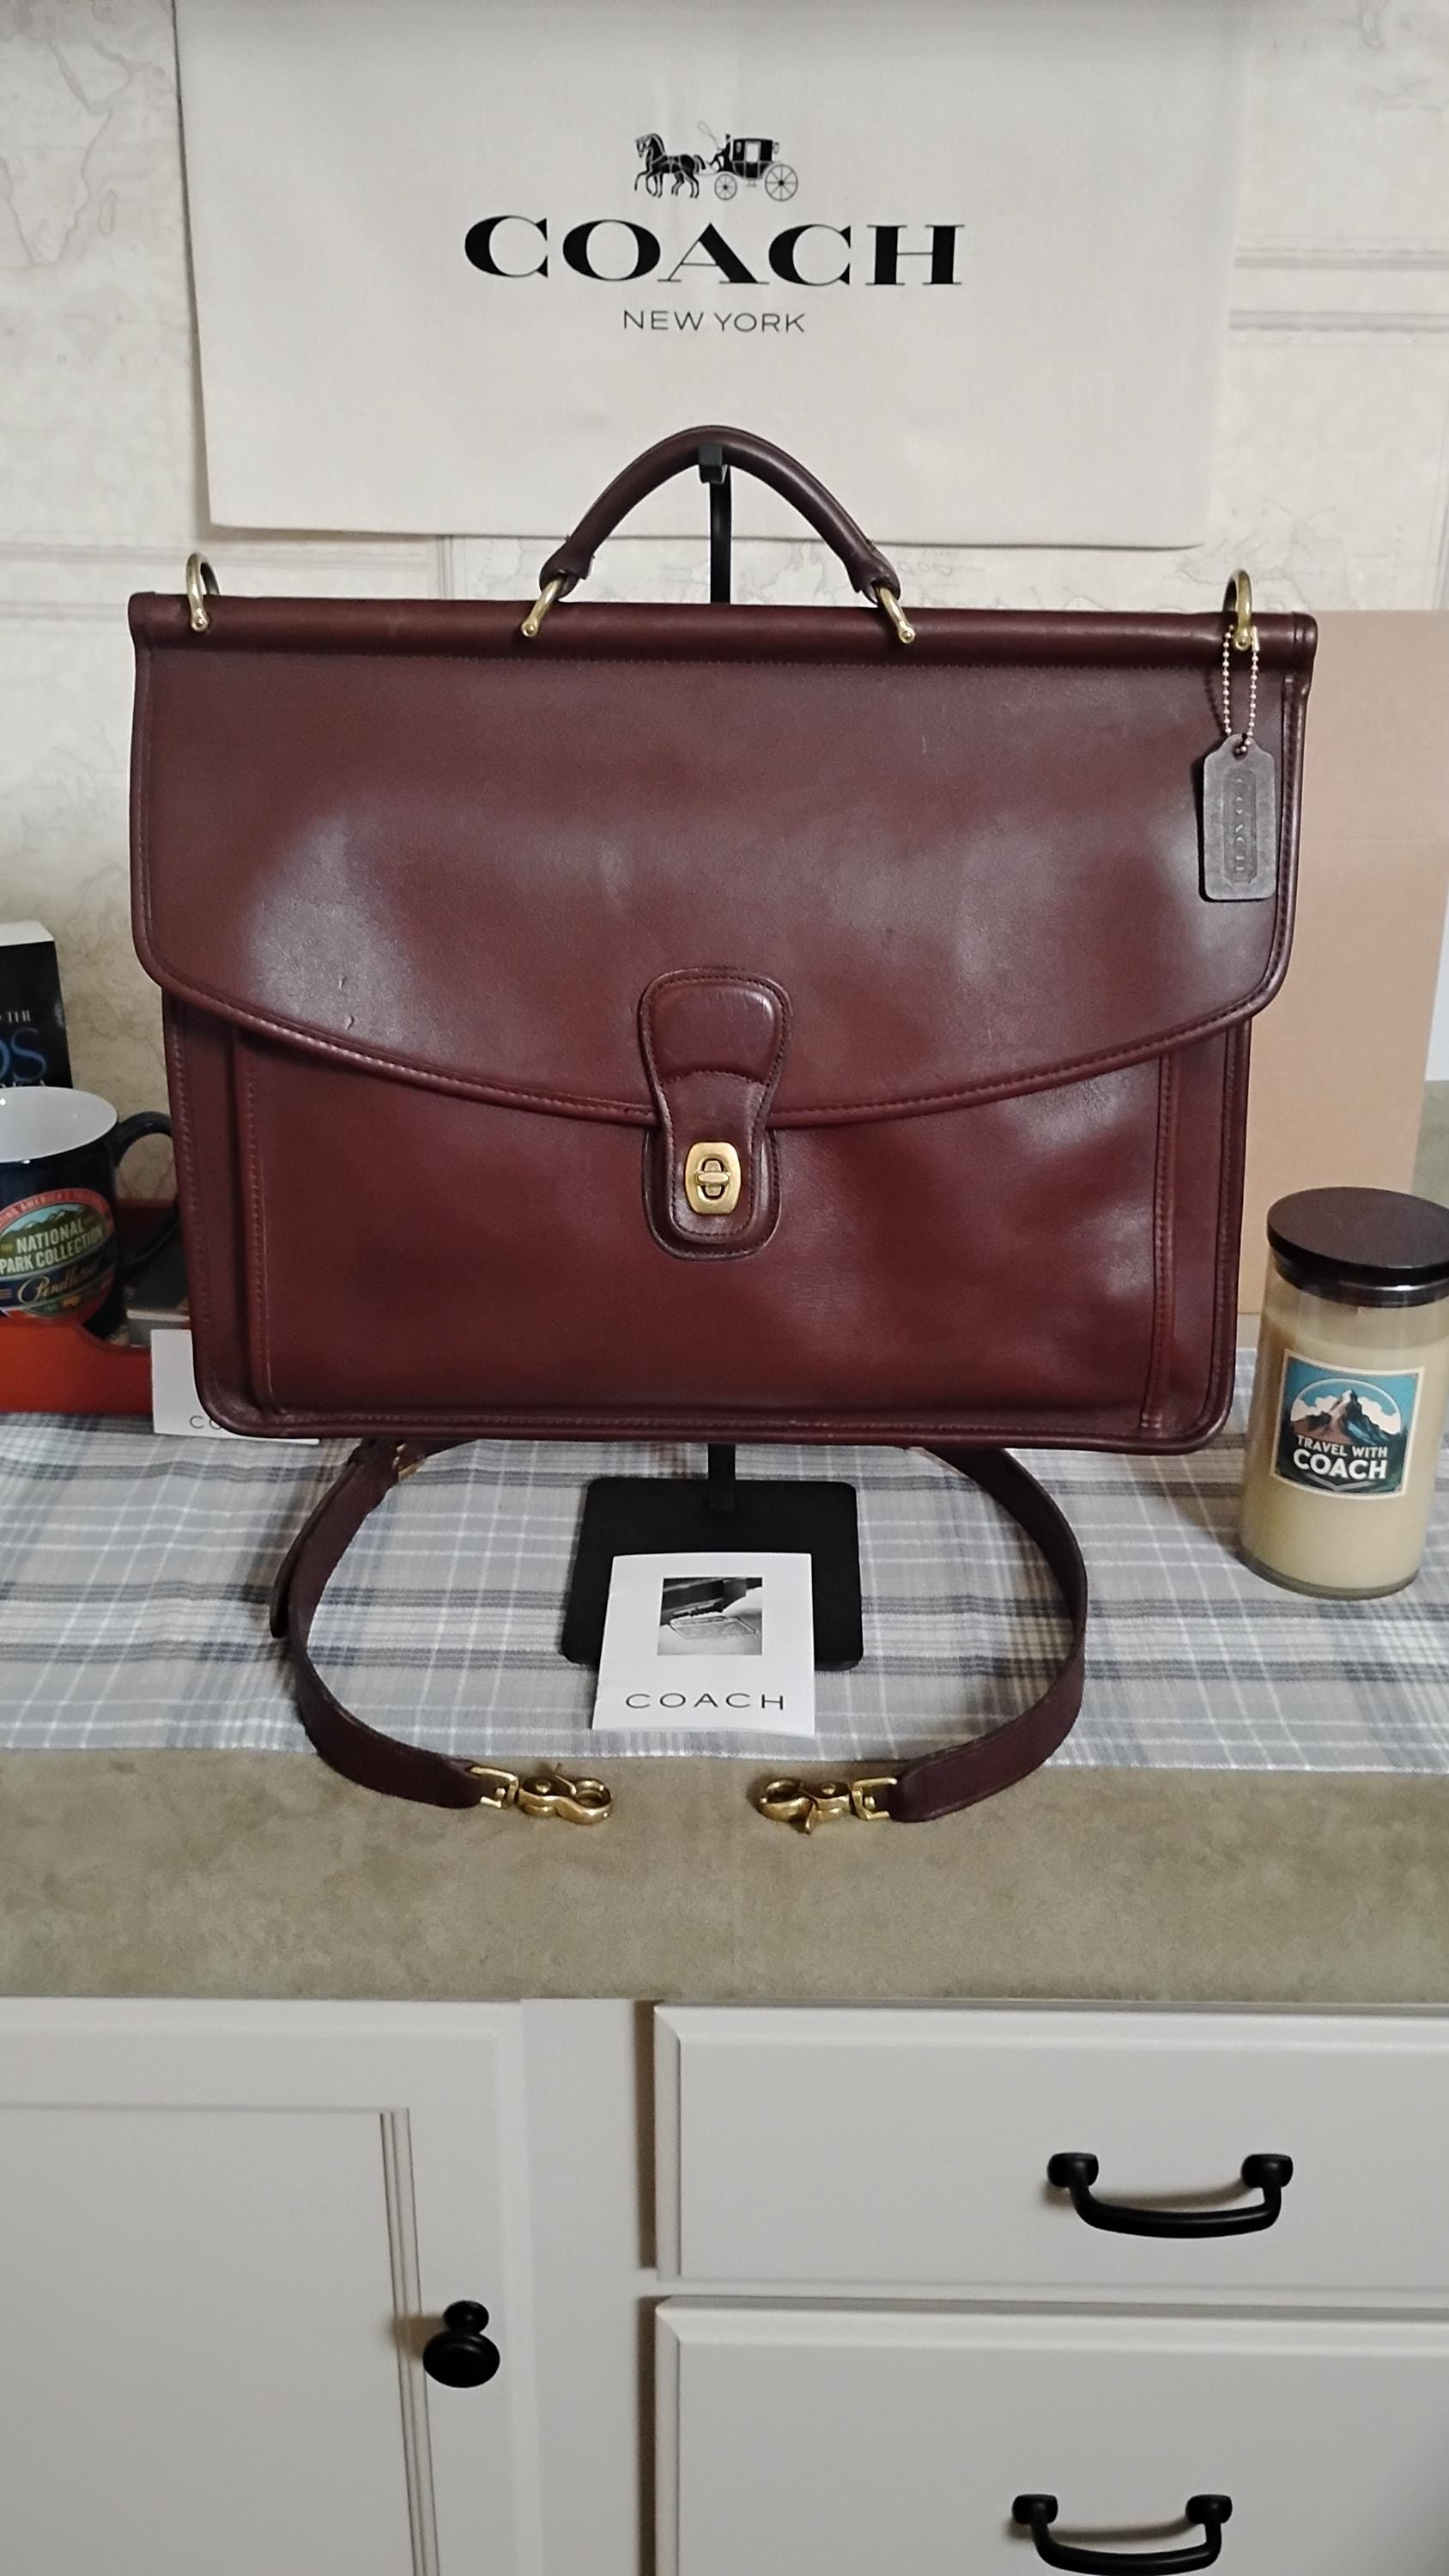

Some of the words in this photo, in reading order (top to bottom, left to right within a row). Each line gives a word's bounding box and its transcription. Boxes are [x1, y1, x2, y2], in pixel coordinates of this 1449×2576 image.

[464, 214, 966, 287] COACH
[623, 309, 705, 331] NEW
[713, 312, 806, 334] YORK
[0, 1255, 33, 1274] PARK
[35, 1224, 103, 1268] COLLECTION
[16, 1218, 84, 1254] NATIONAL
[1296, 1434, 1348, 1456] TRAVEL
[1351, 1445, 1388, 1458] WITH
[1293, 1448, 1388, 1479] COACH
[625, 1692, 785, 1710] COACH
